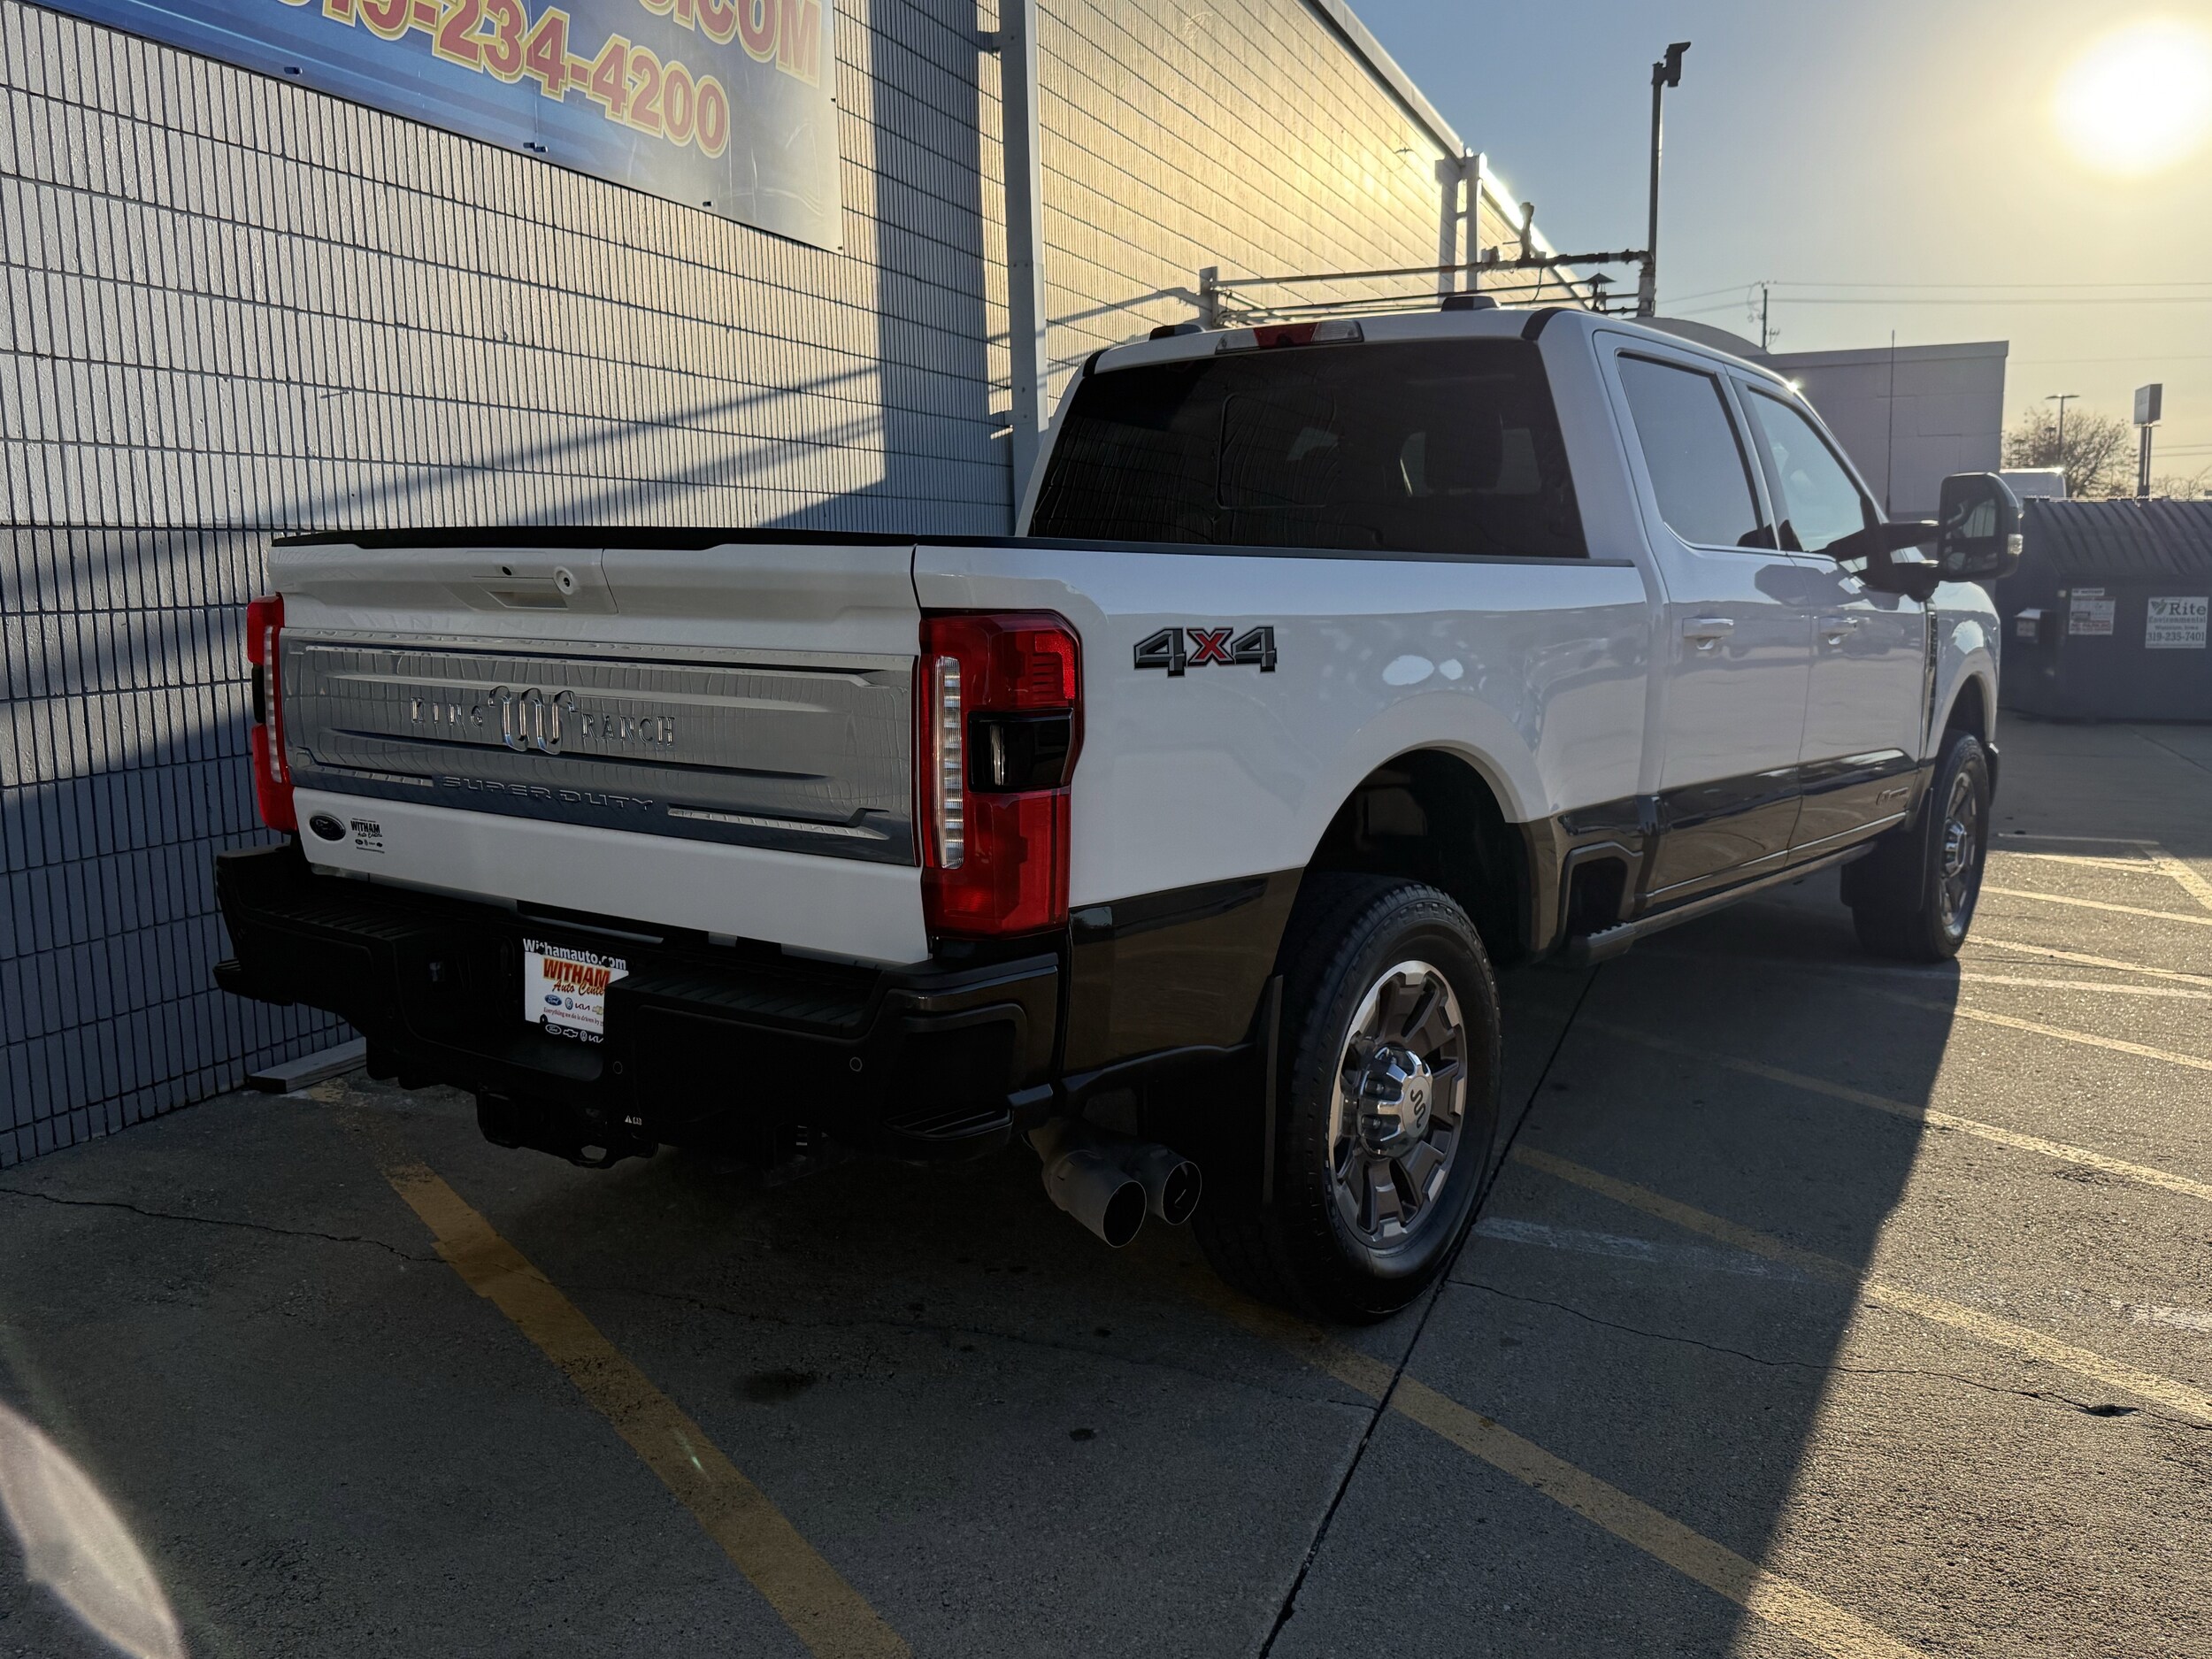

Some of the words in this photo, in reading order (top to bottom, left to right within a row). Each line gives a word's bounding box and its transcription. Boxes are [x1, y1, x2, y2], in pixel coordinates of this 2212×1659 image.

[277, 0, 730, 158] -234-4200
[2169, 602, 2207, 615] Rite
[2147, 632, 2205, 641] 319-235-7401
[411, 696, 484, 728] KING
[581, 712, 675, 747] RANCH
[443, 775, 551, 799] SUPER
[559, 789, 653, 810] DUTY
[350, 820, 380, 833] WITHAM
[544, 958, 611, 988] WITHAM
[552, 979, 575, 994] Auto
[578, 980, 604, 996] Cente
